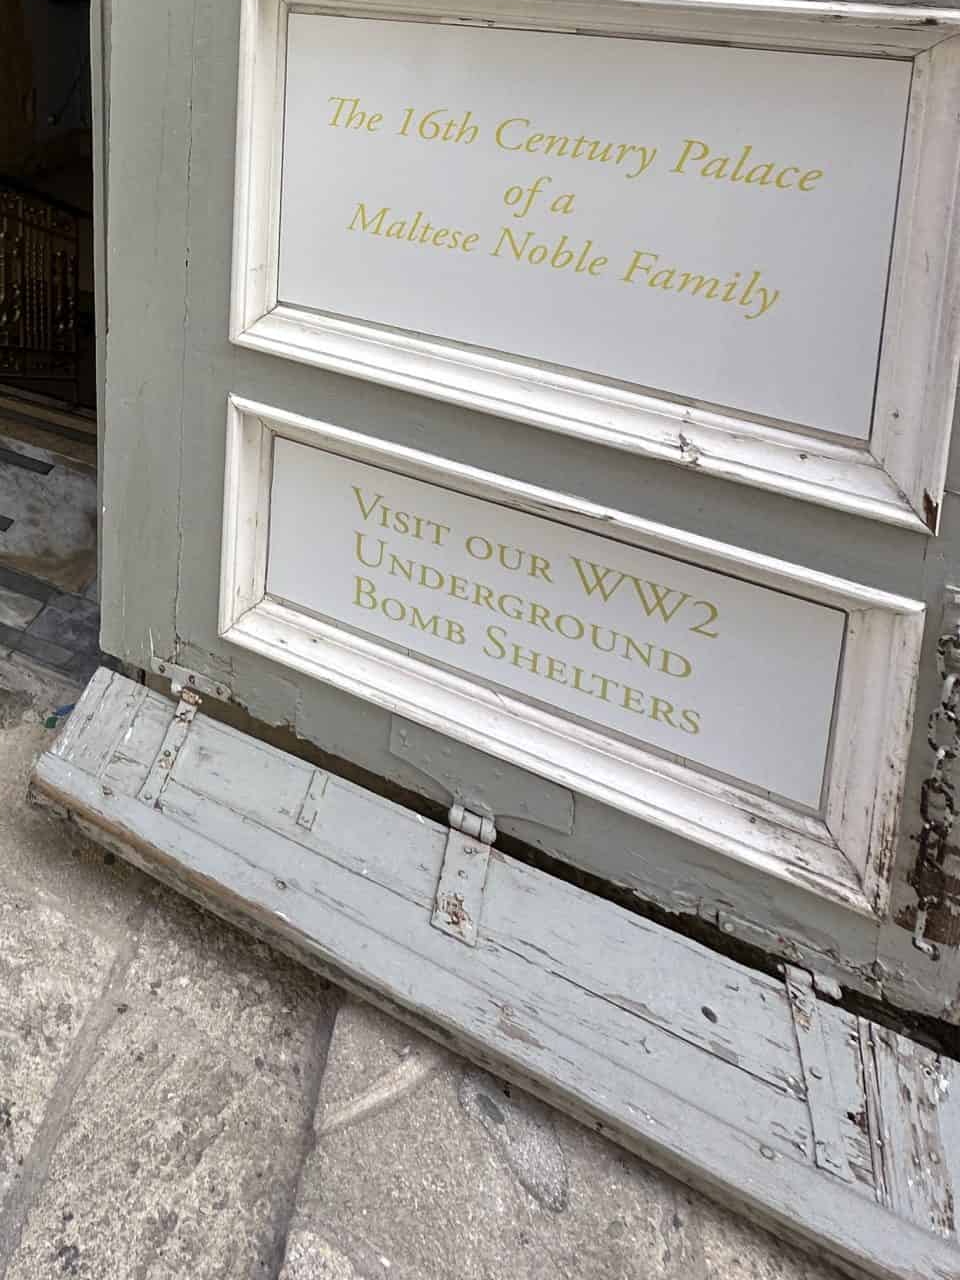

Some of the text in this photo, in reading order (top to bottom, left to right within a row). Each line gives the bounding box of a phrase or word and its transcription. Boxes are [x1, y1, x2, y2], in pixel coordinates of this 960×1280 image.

[327, 96, 826, 195] The 16th Century Palace
[503, 176, 576, 218] of a
[345, 203, 782, 320] Maltese Noble Family
[351, 485, 720, 640] VISIT OUR WW2
[352, 532, 694, 681] UNDERGROUND
[352, 577, 703, 737] BOMB SHELTERS
